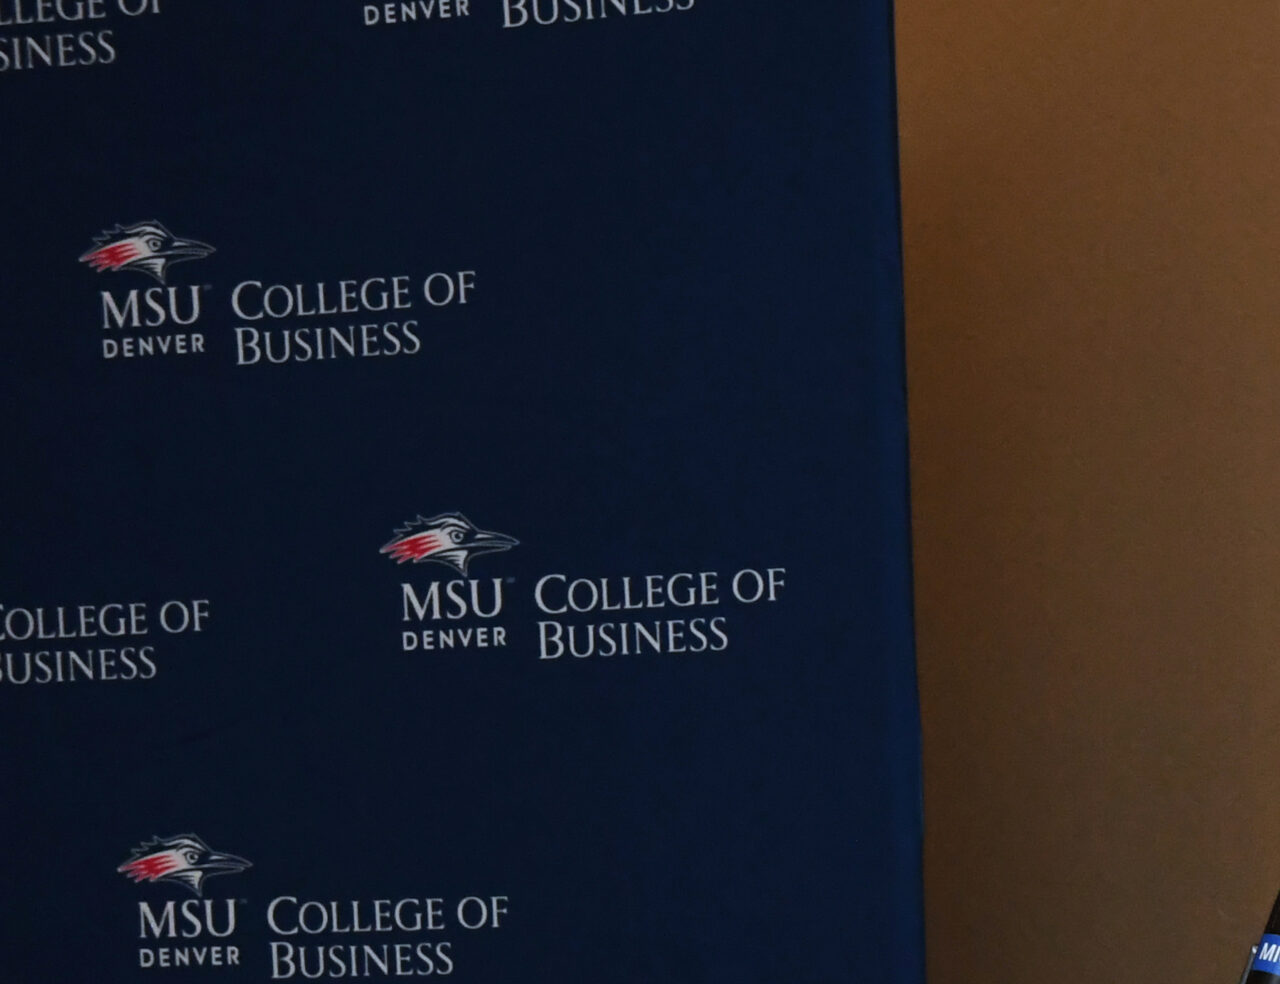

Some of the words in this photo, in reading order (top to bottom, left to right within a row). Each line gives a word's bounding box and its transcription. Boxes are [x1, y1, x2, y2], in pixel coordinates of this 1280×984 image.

[363, 0, 470, 26] DENVER
[100, 286, 200, 329] MSU
[102, 334, 205, 359] DENVER
[401, 578, 503, 622] MSU
[0, 602, 148, 641] OLLEGE
[402, 627, 507, 651] DENVER
[0, 646, 157, 685] USINESS
[138, 898, 236, 939] MSU
[139, 945, 240, 968] DENVER
